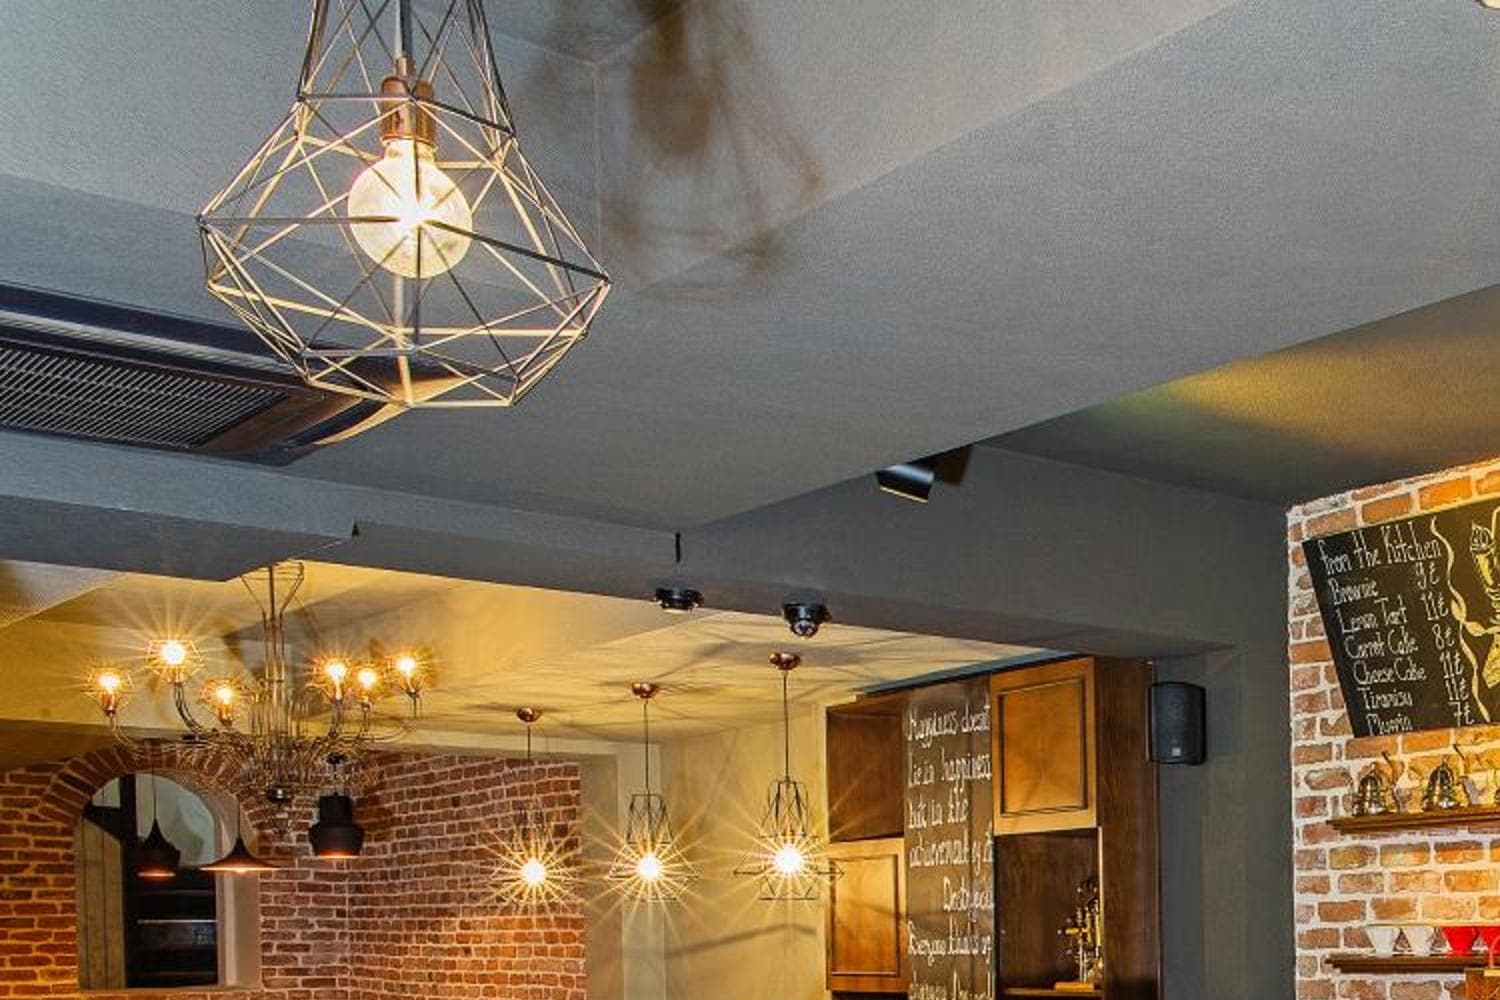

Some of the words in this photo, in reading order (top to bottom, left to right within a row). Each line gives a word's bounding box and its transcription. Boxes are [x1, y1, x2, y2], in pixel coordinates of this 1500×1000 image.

[1380, 521, 1442, 564] Kitchen
[1327, 577, 1379, 605] Brownie
[1336, 608, 1378, 635] Lemon
[1374, 594, 1408, 625] Tart
[1344, 632, 1385, 659] Carrot
[1387, 626, 1419, 655] Cake
